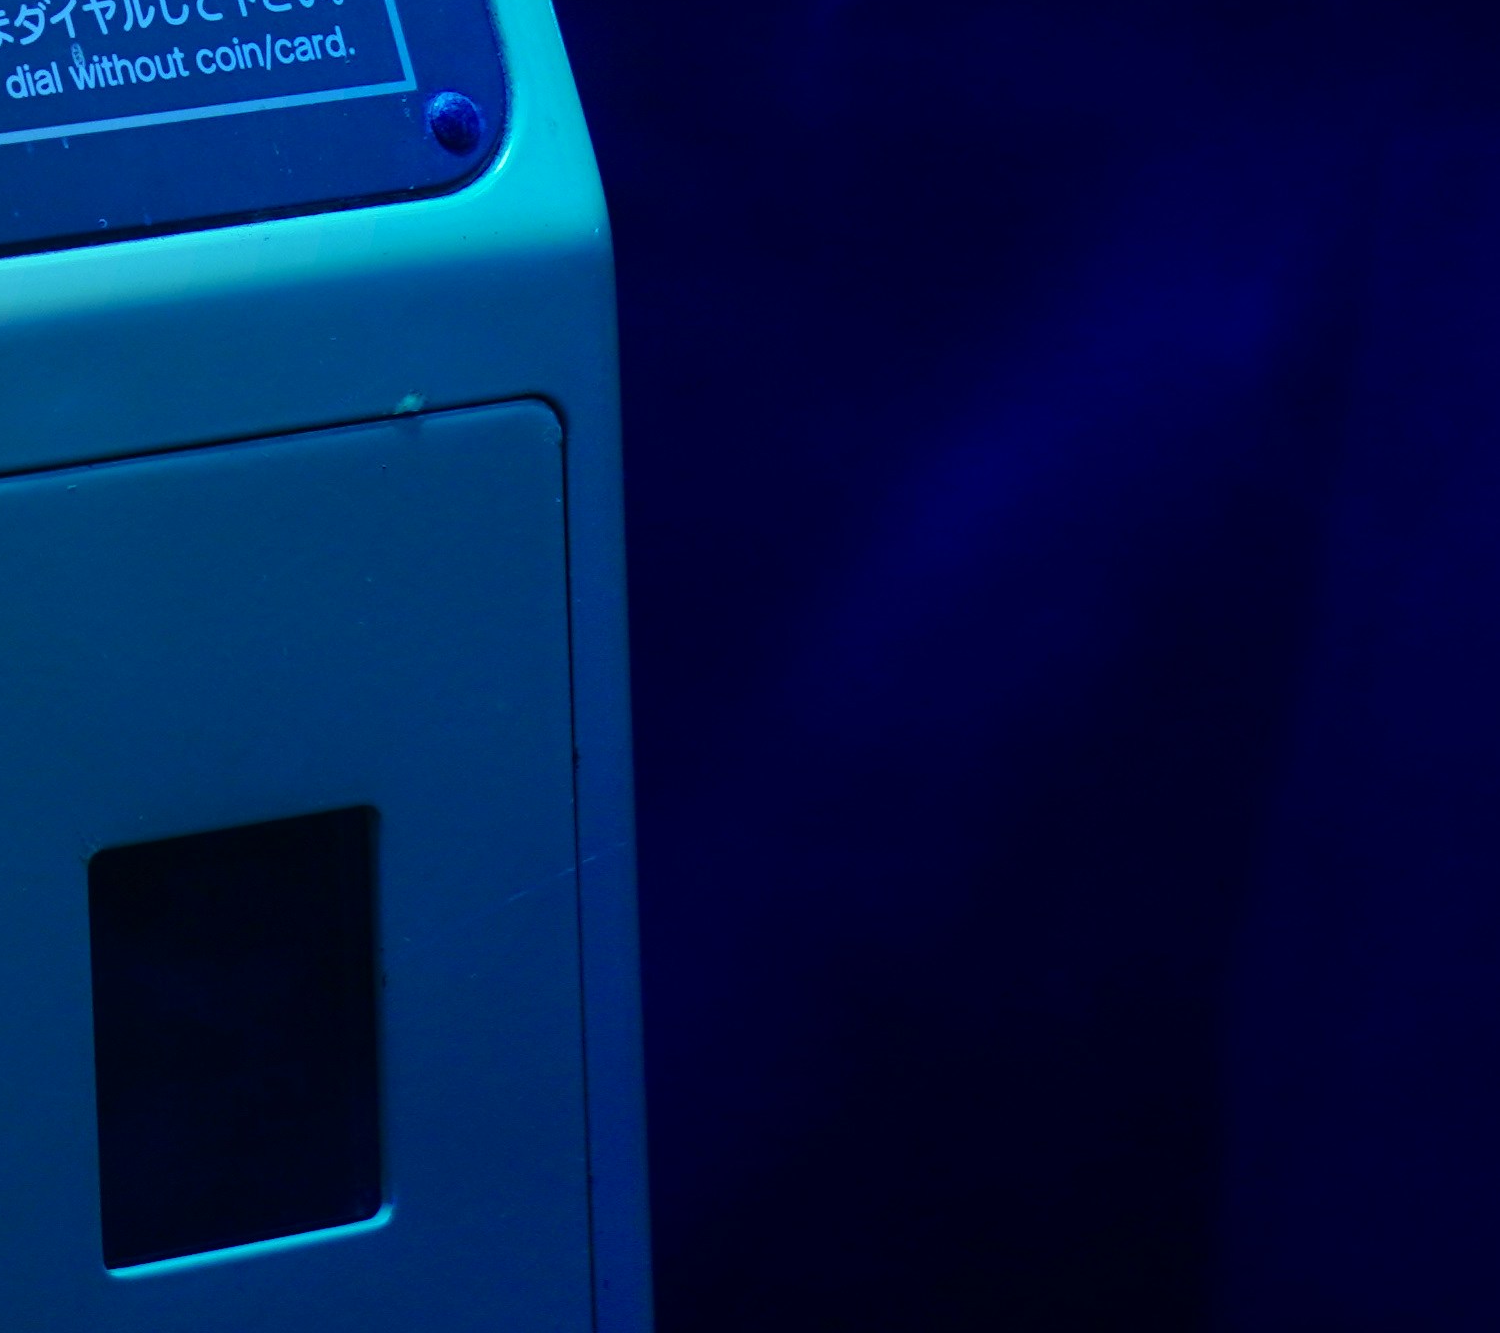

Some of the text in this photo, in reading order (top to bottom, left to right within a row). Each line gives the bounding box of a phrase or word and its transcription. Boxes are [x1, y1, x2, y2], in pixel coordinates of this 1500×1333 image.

[5, 62, 64, 99] dial
[68, 44, 190, 92] without
[195, 25, 356, 76] coin/card.
